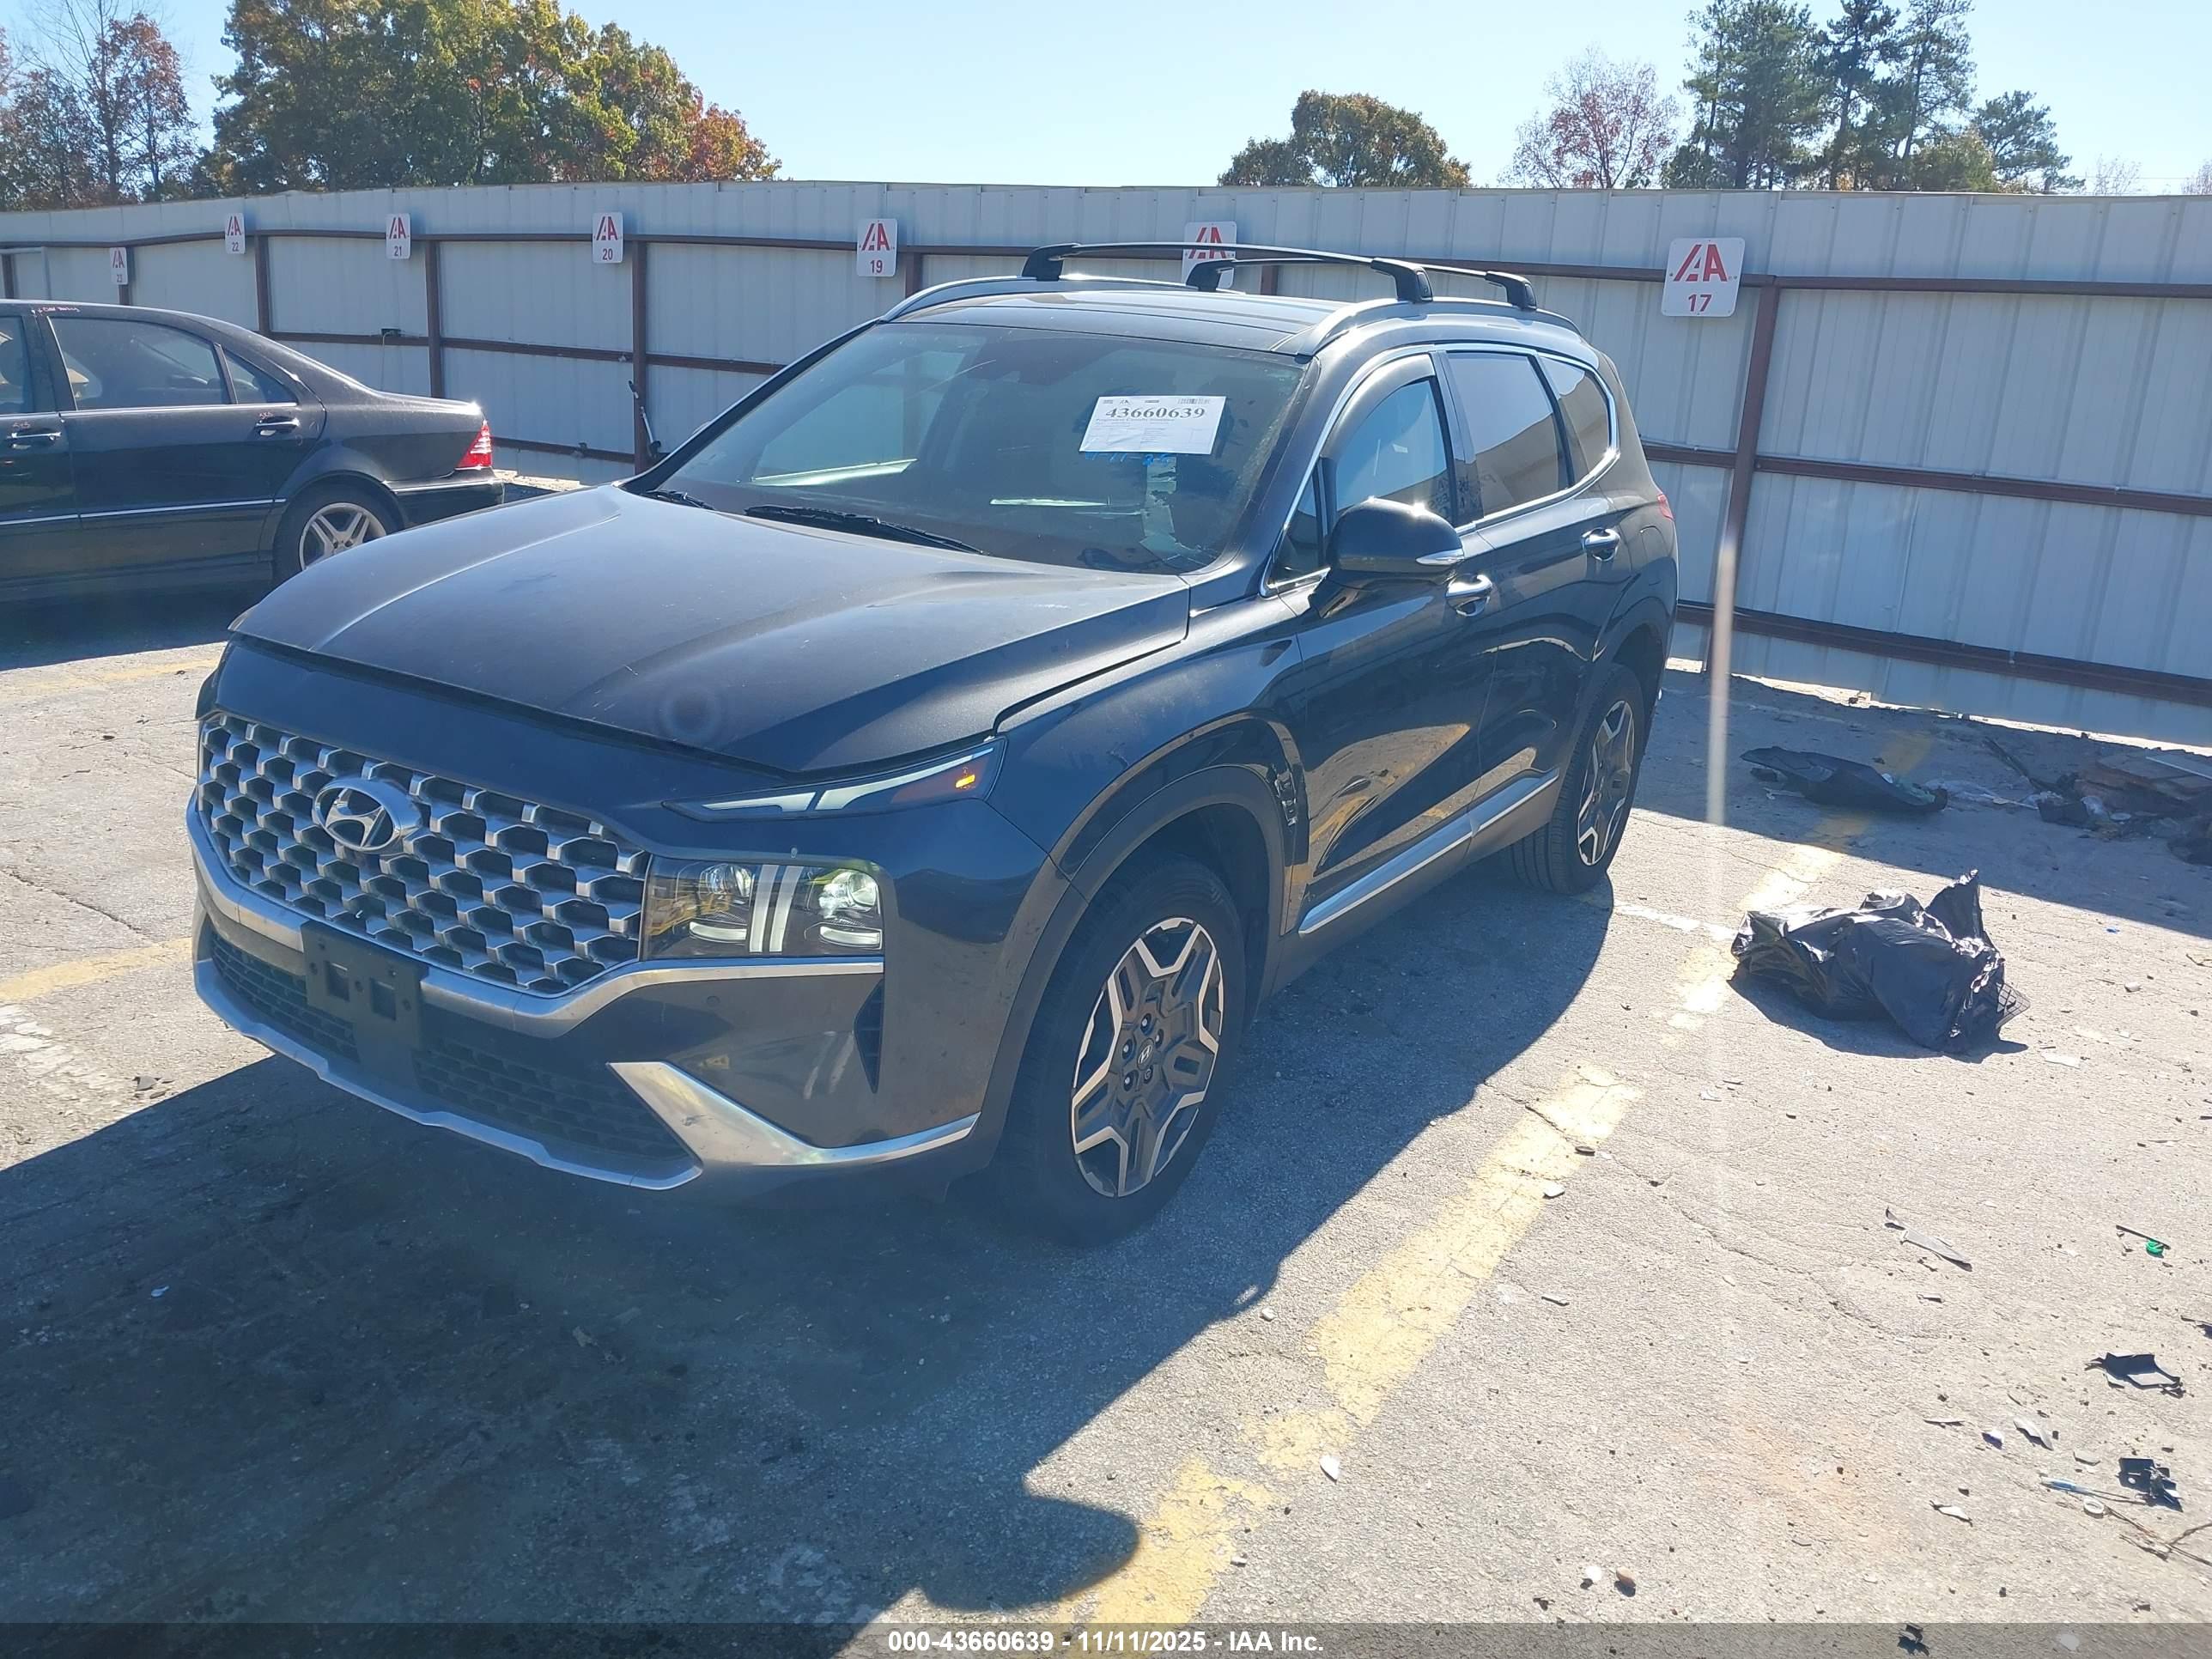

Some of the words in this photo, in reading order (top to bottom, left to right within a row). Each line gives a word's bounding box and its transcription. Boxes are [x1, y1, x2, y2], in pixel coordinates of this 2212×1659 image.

[232, 241, 240, 252] 22
[394, 246, 402, 257] 21
[603, 248, 613, 260] 20
[870, 259, 883, 273] 19
[1688, 294, 1712, 312] 17
[1105, 407, 1206, 418] 43660639
